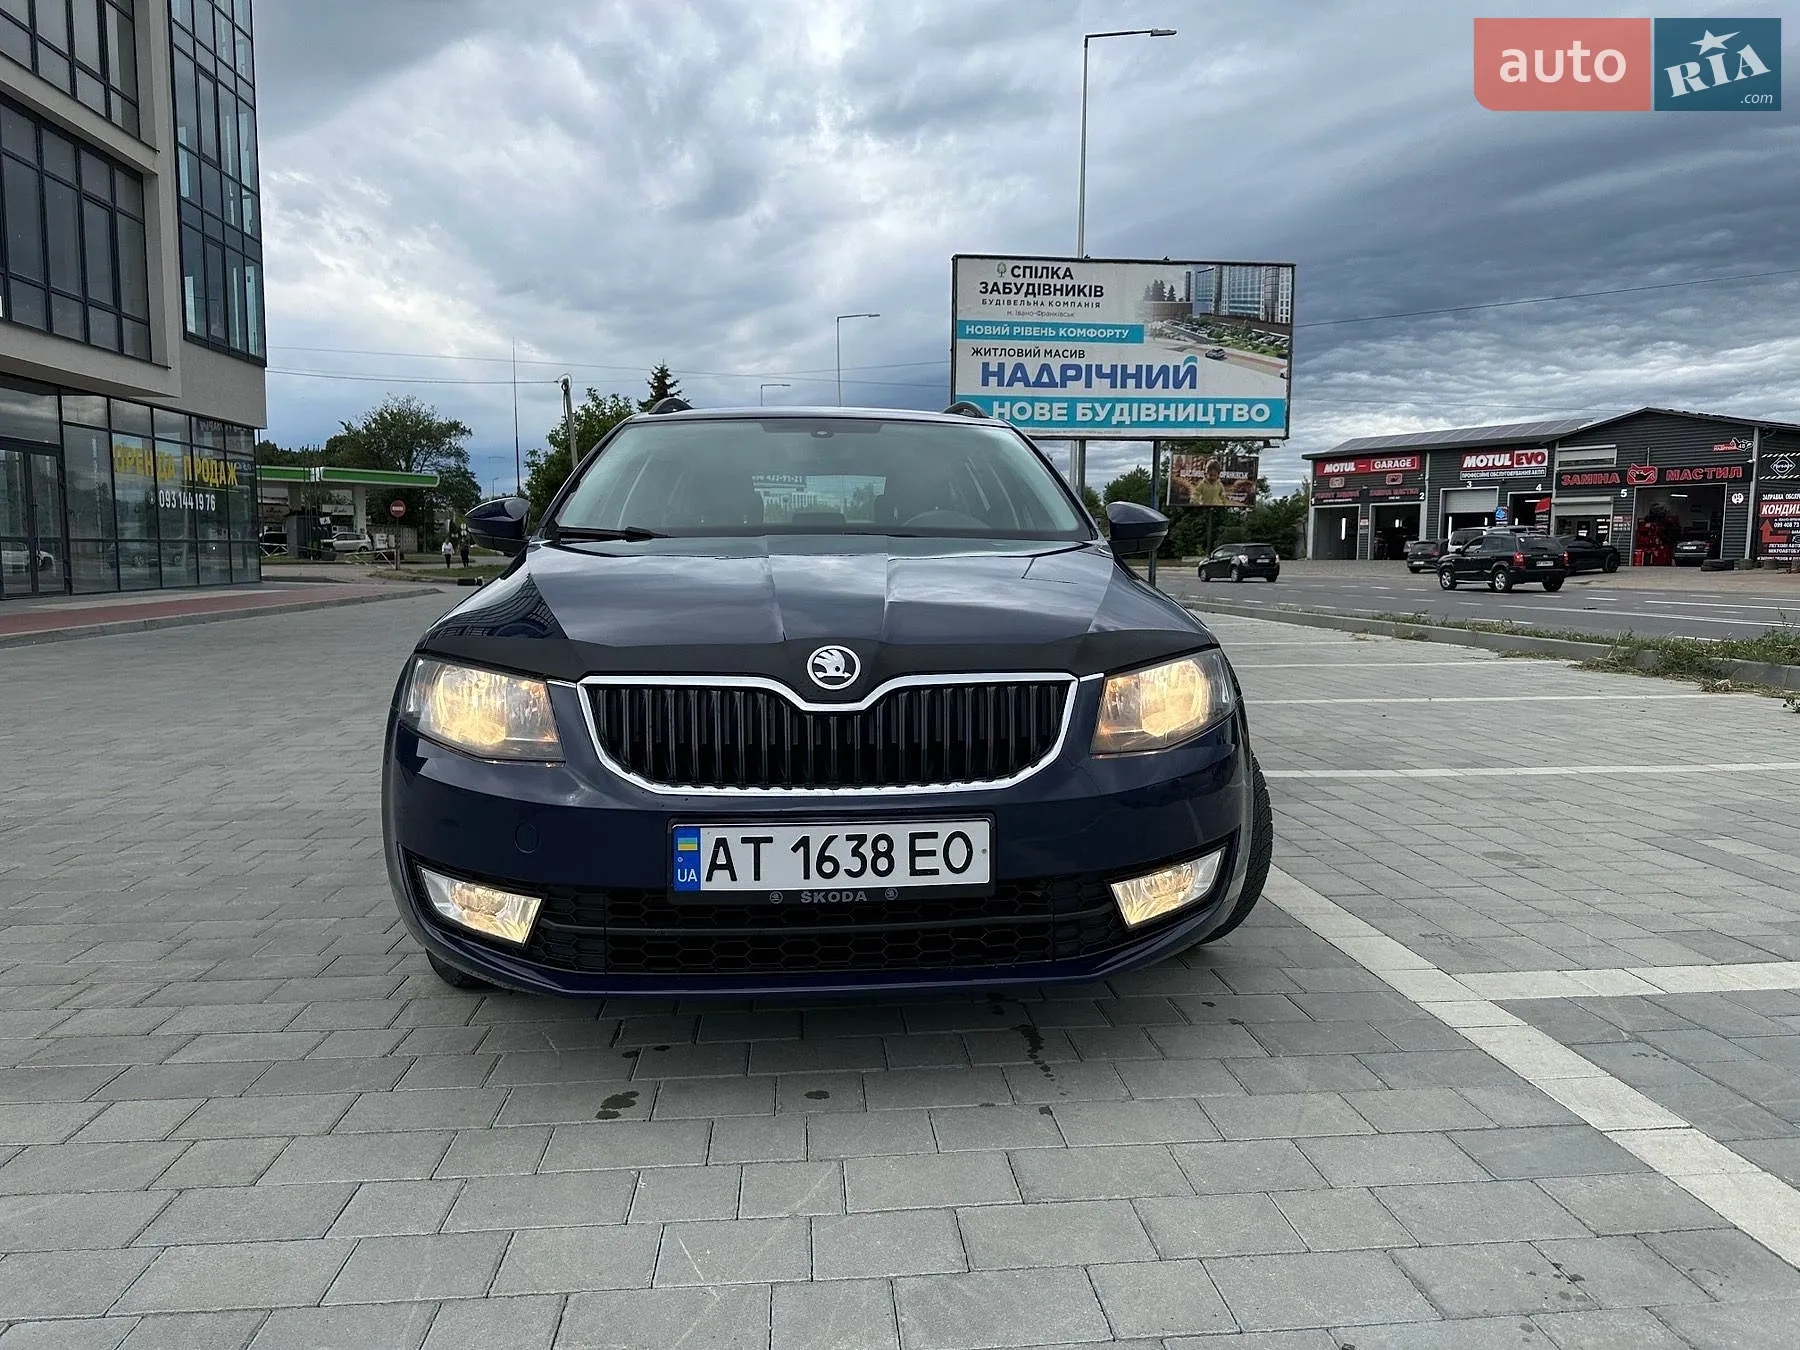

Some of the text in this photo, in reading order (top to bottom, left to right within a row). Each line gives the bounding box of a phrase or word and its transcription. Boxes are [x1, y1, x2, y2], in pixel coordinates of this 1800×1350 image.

[1010, 265, 1074, 280] СПІЛКА
[979, 281, 1104, 298] ЗАБУДІВНИКІВ
[981, 299, 1101, 309] БУДІВЕЛЬНА КОМПАНІЯ
[965, 324, 1129, 340] НОВИЙ РІВЕНЬ КОМФОРТУ
[971, 345, 1086, 360] ЖИТЛОВИЙ МАСИВ
[981, 356, 1198, 390] НАДРІЧНИЙ
[992, 400, 1271, 425] НОВЕ БУДІВНИЦТВО
[1324, 458, 1412, 473] MOTUL GARAGE
[1463, 451, 1546, 468] MOTUL EVO
[183, 456, 239, 488] ПРОДАЖ
[1561, 466, 1743, 486] ЗАМІНА МАСТИЛ
[1466, 480, 1472, 488] 3
[1535, 483, 1542, 491] 4
[1419, 492, 1424, 500] 2
[1620, 489, 1627, 498] 5
[705, 830, 973, 882] AT 1638 EO
[677, 869, 698, 883] UA
